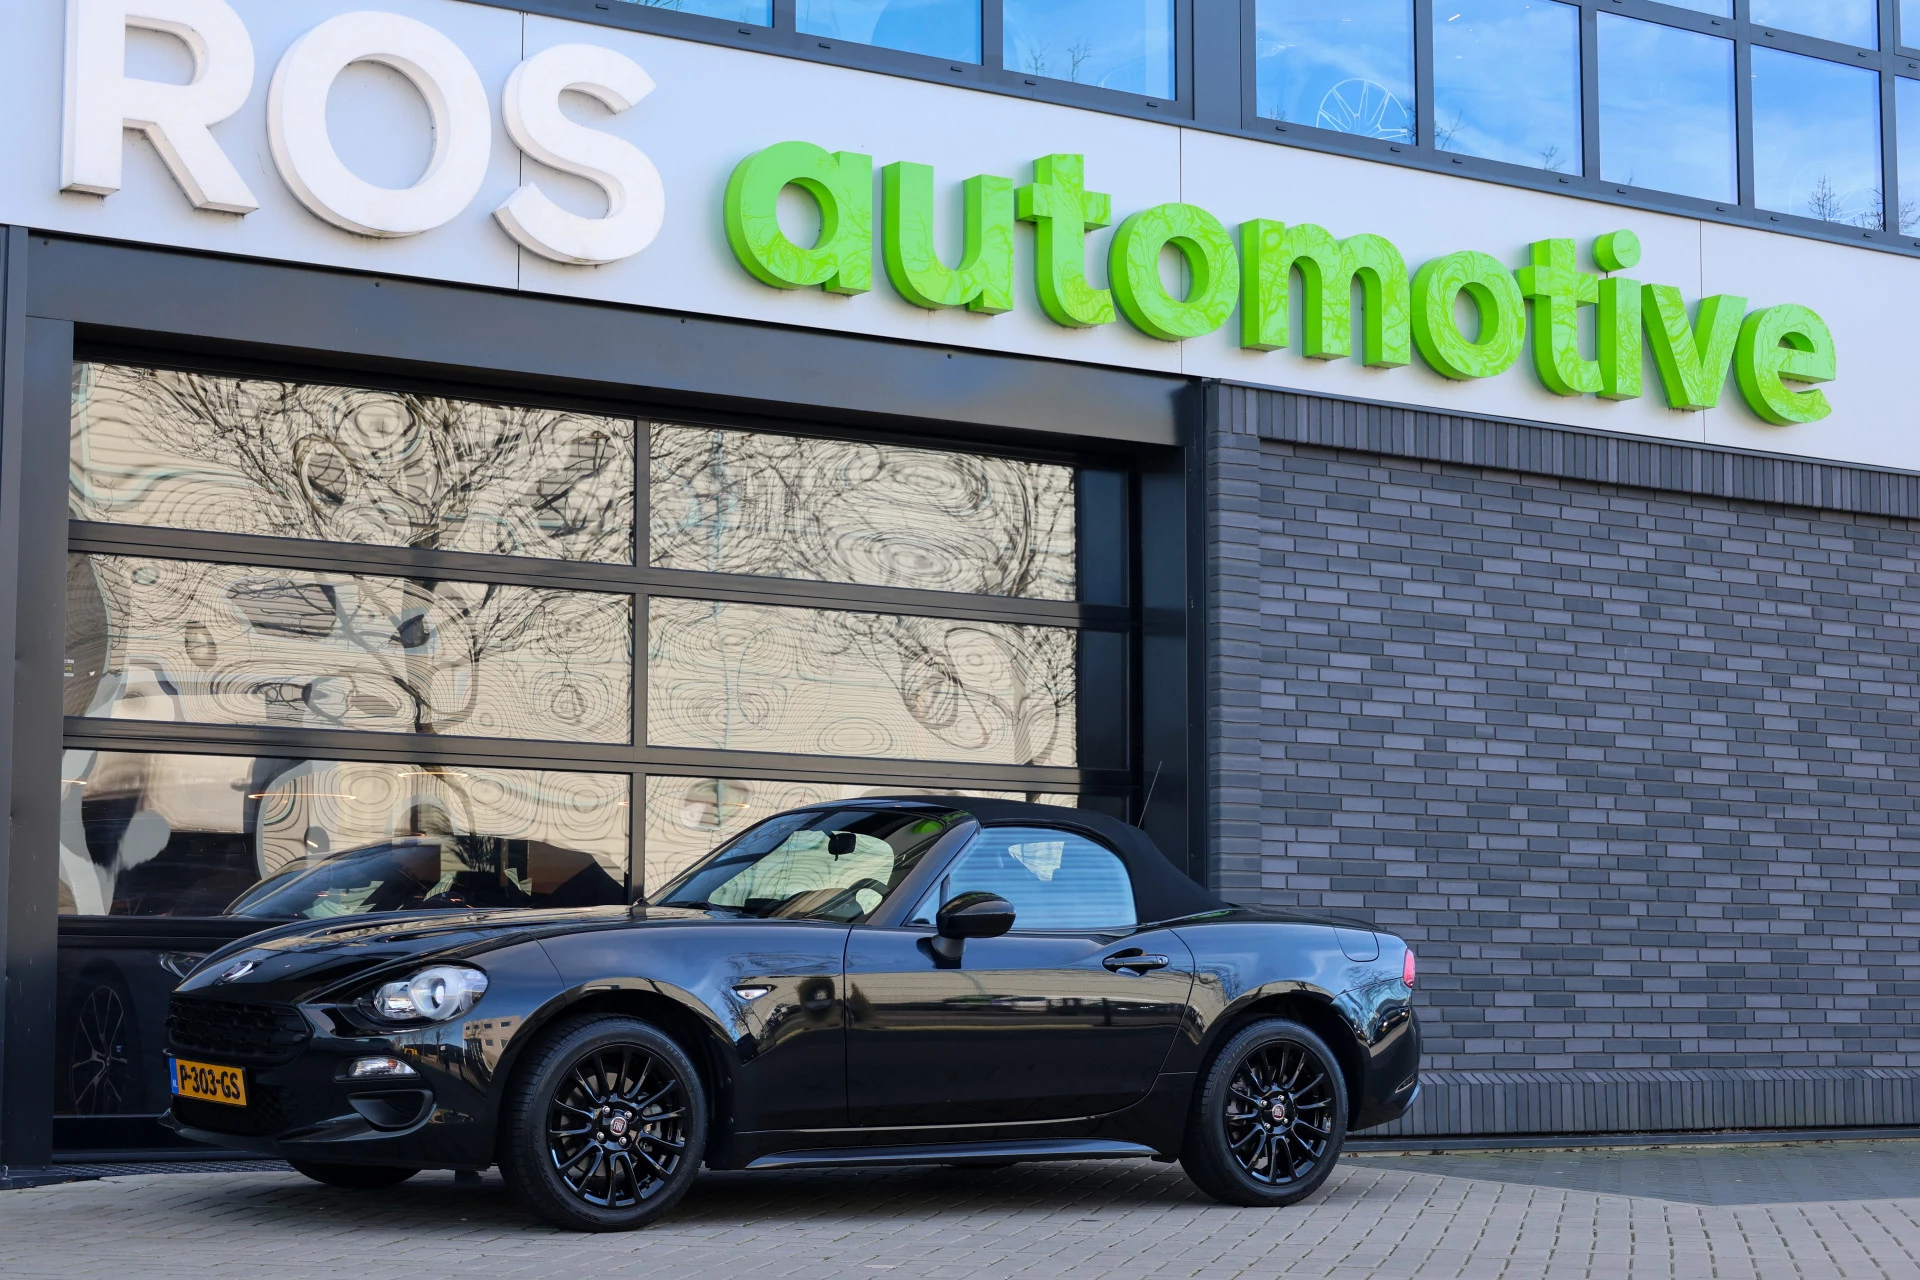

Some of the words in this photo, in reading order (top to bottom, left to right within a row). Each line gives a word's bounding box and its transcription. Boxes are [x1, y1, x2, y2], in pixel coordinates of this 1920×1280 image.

[60, 0, 665, 266] ROS
[723, 140, 1837, 426] automotive
[179, 1064, 241, 1100] P-303-GS
